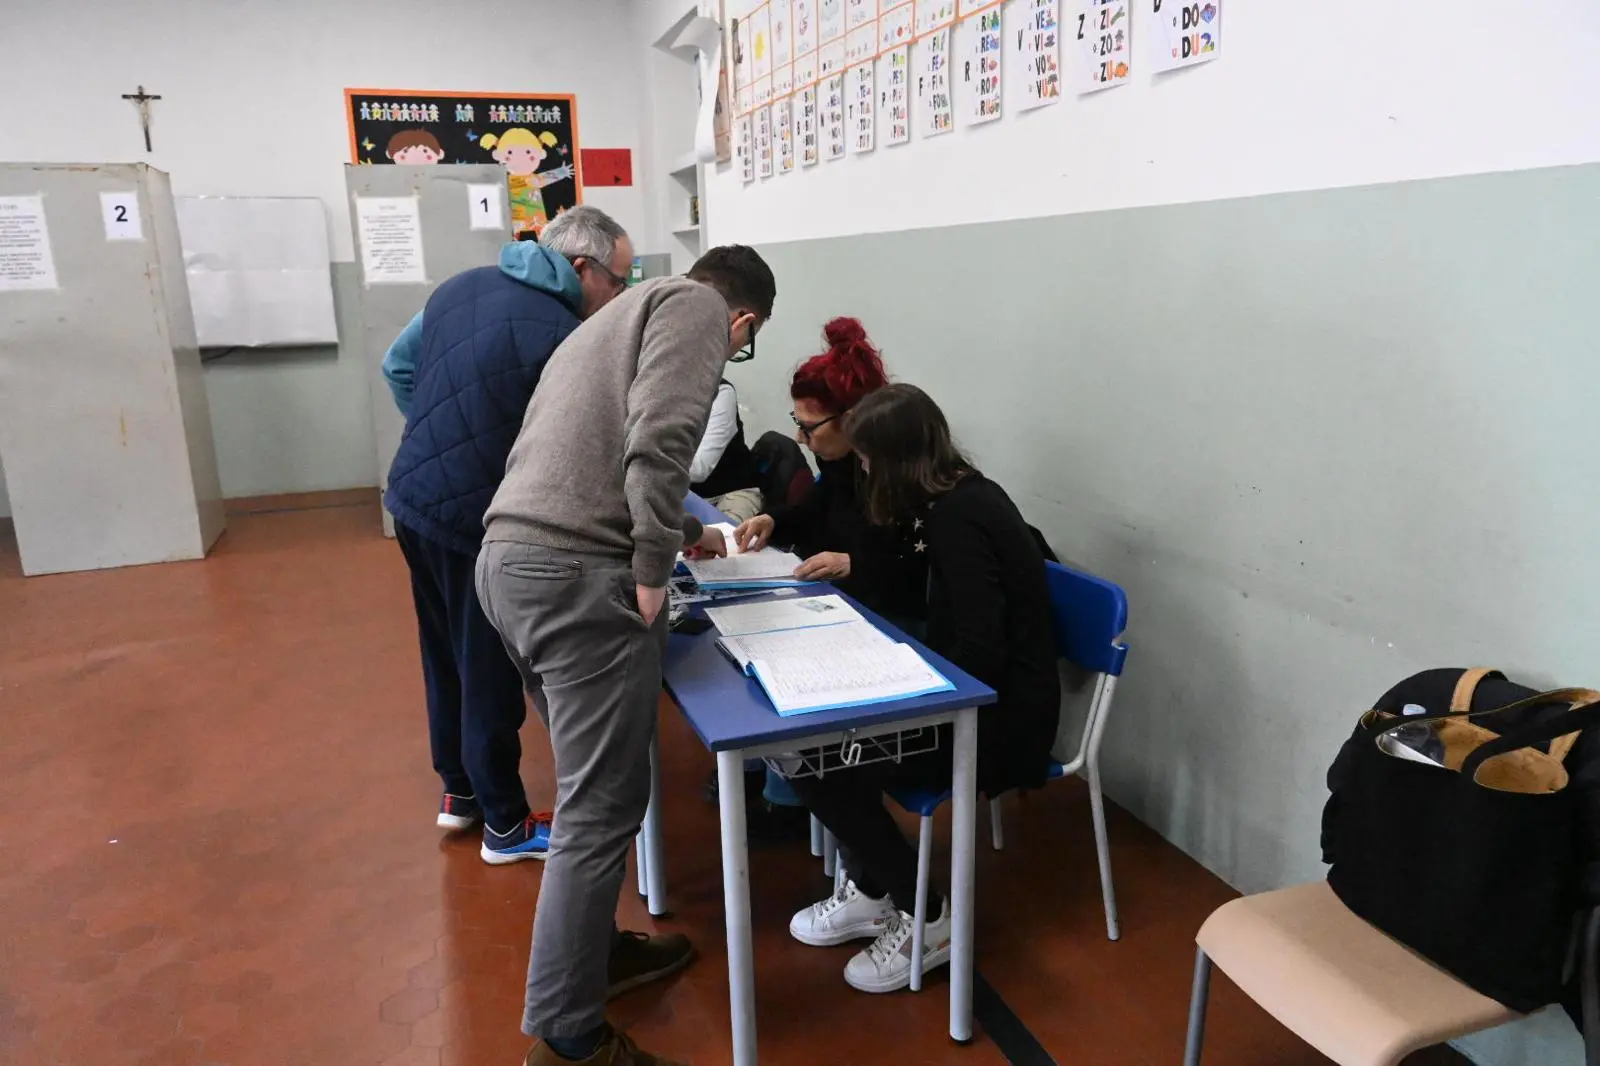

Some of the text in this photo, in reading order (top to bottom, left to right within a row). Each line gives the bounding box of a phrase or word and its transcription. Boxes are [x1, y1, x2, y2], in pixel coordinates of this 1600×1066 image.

[1035, 10, 1046, 31] VE
[1077, 13, 1085, 41] Z
[1100, 8, 1110, 31] ZI
[1182, 3, 1200, 30] DO
[1017, 29, 1024, 52] V
[1034, 32, 1044, 52] VI
[1100, 33, 1113, 56] ZO
[1182, 32, 1200, 59] DU
[964, 60, 971, 82] R
[1035, 54, 1047, 76] VO
[1100, 60, 1113, 82] ZU
[980, 76, 991, 96] RO
[1036, 78, 1049, 99] VU
[114, 205, 129, 222] 2
[480, 197, 489, 213] 1
